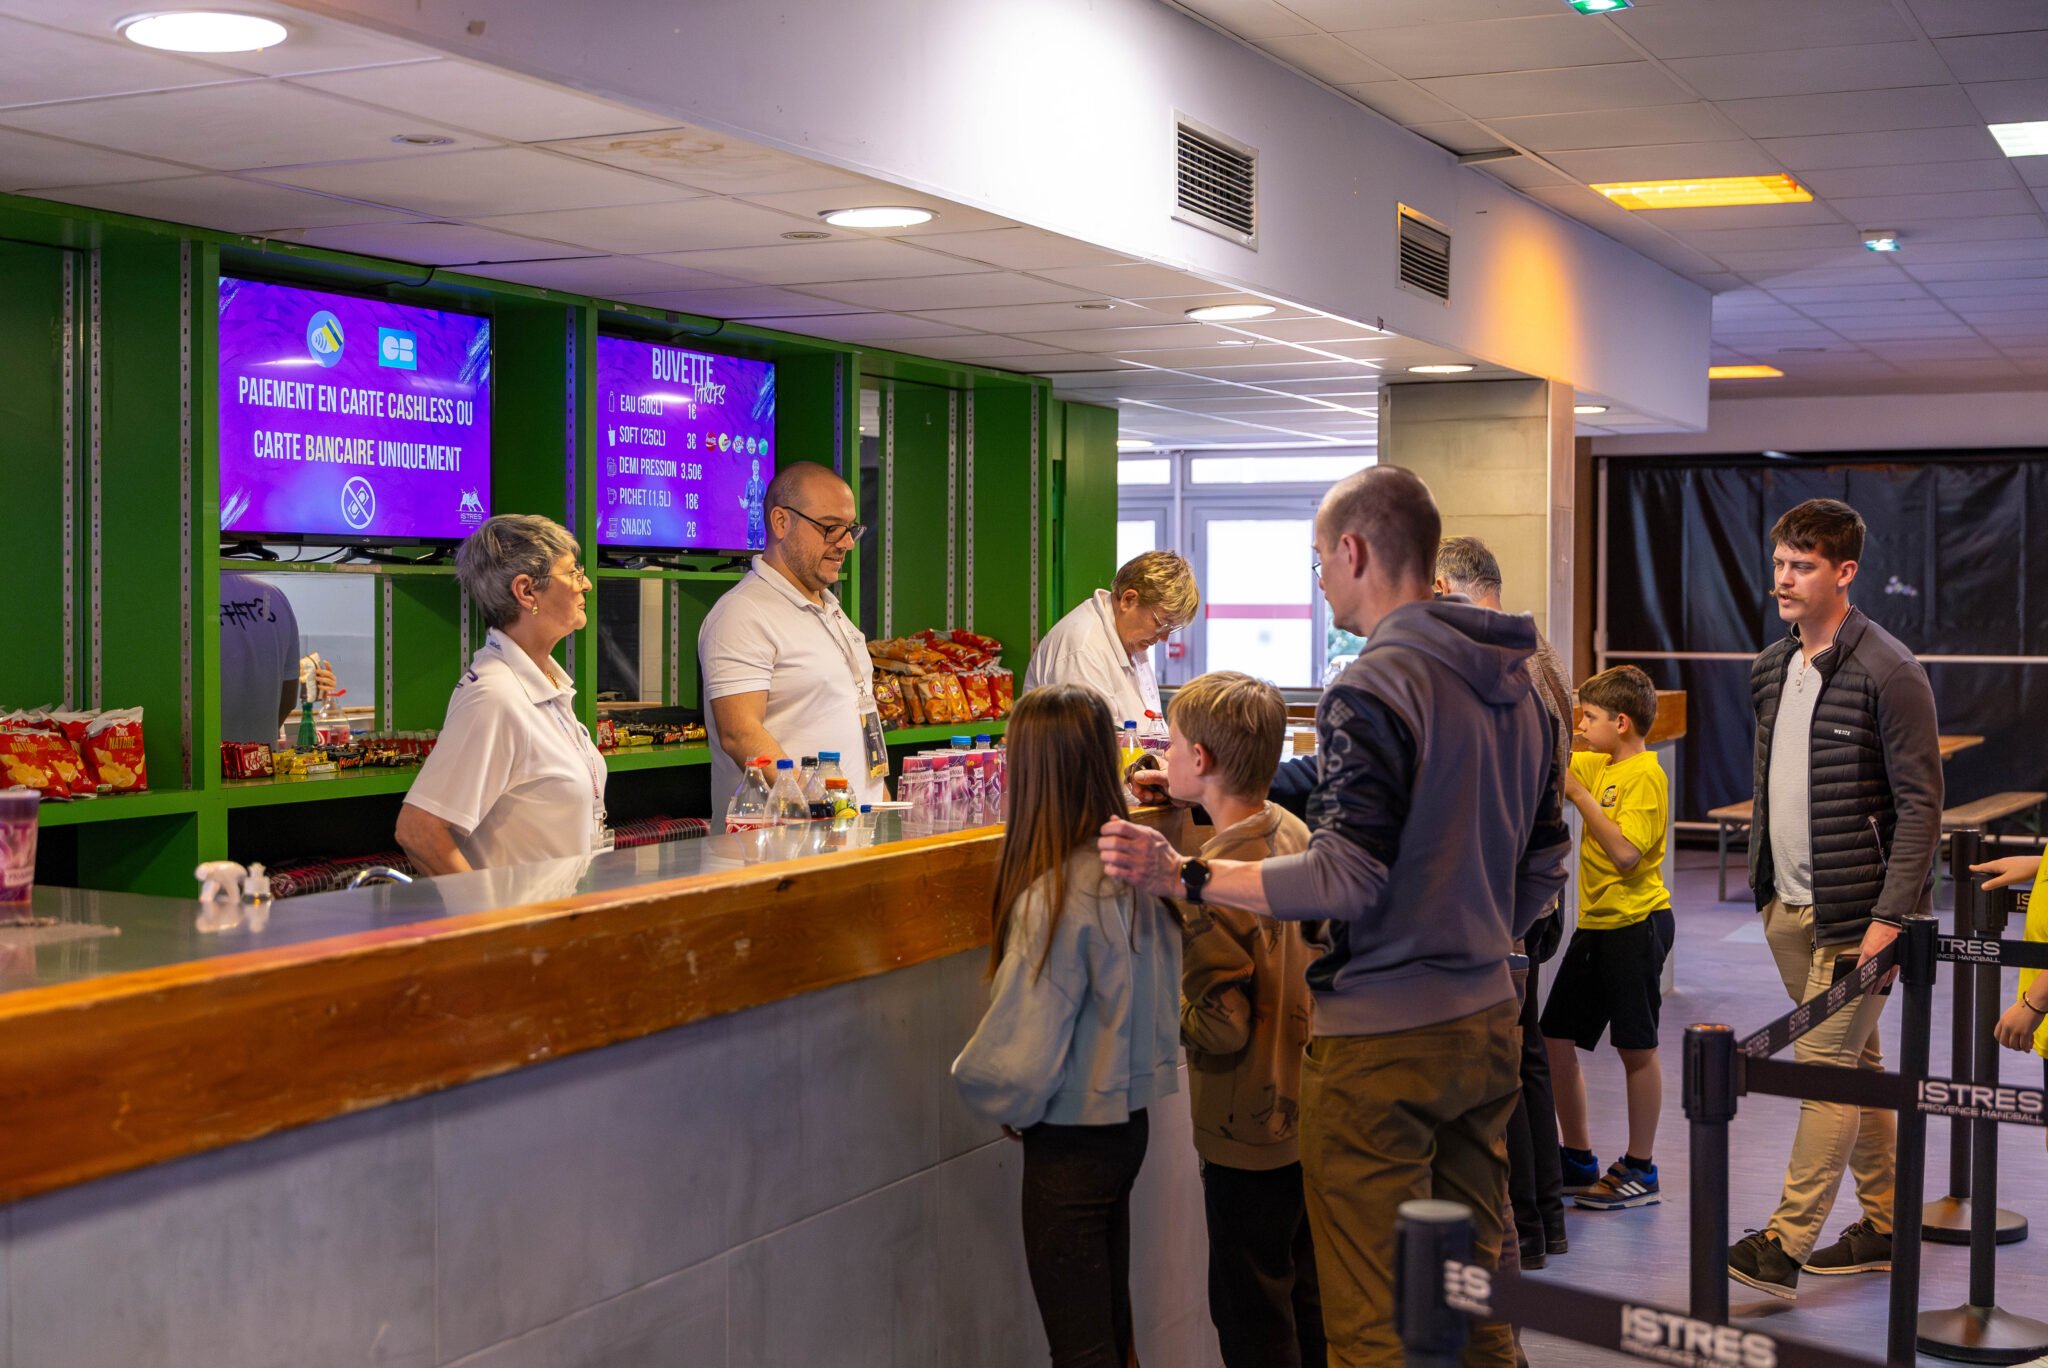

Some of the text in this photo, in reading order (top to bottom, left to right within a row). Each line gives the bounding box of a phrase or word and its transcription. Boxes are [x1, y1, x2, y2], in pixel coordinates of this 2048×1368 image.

[652, 347, 714, 387] BUVETTE
[239, 376, 473, 426] PAIEMENT EN CARTE CASHLESS OU
[620, 394, 697, 420] EAU (50CL) 1€
[619, 425, 697, 450] SOFT (25CL) 3€
[254, 430, 462, 472] CARTE BANCAIRE UNIQUEMENT
[619, 456, 639, 474] DEMI
[640, 458, 677, 478] PRESSION
[619, 487, 647, 506] PICHET
[685, 493, 699, 510] 18€
[621, 518, 697, 538] SNACKS 2€
[109, 736, 136, 750] NATURE
[1937, 937, 2001, 957] TRES
[1957, 954, 2001, 963] HANDBALL
[1918, 1080, 2043, 1113] ISTRES
[1917, 1102, 2044, 1125] PROVENCE HANDBALL
[1621, 1304, 1777, 1368] ISTRES
